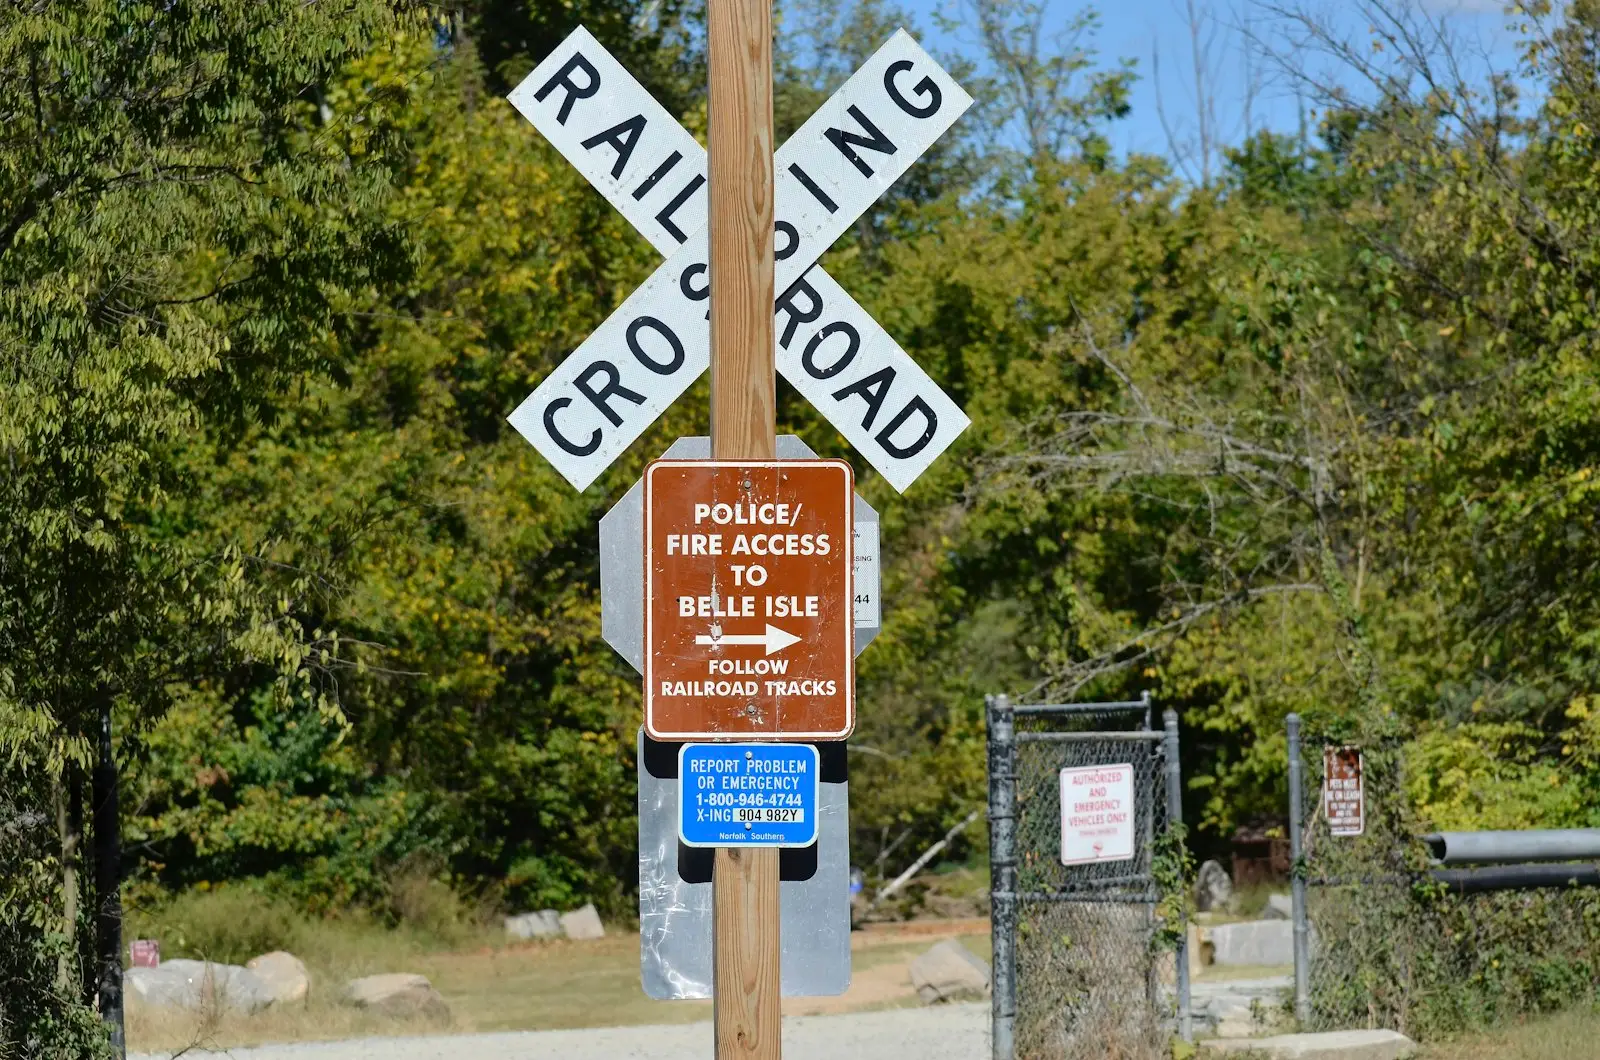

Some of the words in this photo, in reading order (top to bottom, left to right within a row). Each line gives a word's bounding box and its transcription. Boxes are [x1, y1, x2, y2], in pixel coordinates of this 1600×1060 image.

[533, 51, 706, 244] RAIL
[694, 503, 802, 527] POLICE/
[667, 534, 722, 555] FIRE
[731, 533, 831, 556] ACCESS
[731, 565, 768, 586] TO
[679, 596, 755, 617] BELLE
[766, 595, 819, 617] ISLE
[708, 659, 788, 675] FOLLOW
[661, 680, 758, 696] RAILROAD
[765, 680, 837, 696] TRACKS
[690, 759, 740, 773] REPORT
[746, 759, 807, 773] PROBLEM
[697, 776, 715, 790] OR
[722, 776, 800, 790] EMERGENCY
[1072, 772, 1122, 785] AUTHORIZED
[1089, 787, 1107, 797] AND
[696, 793, 803, 807] 1-800-946-4744
[1074, 799, 1121, 813] EMERGENCY
[697, 808, 731, 822] X-ING
[739, 808, 762, 822] 904
[766, 808, 798, 822] 982Y
[1068, 814, 1105, 827] VEHICLES
[1107, 813, 1127, 824] ONLY
[719, 832, 746, 840] Norfolk
[751, 832, 785, 841] Southern
